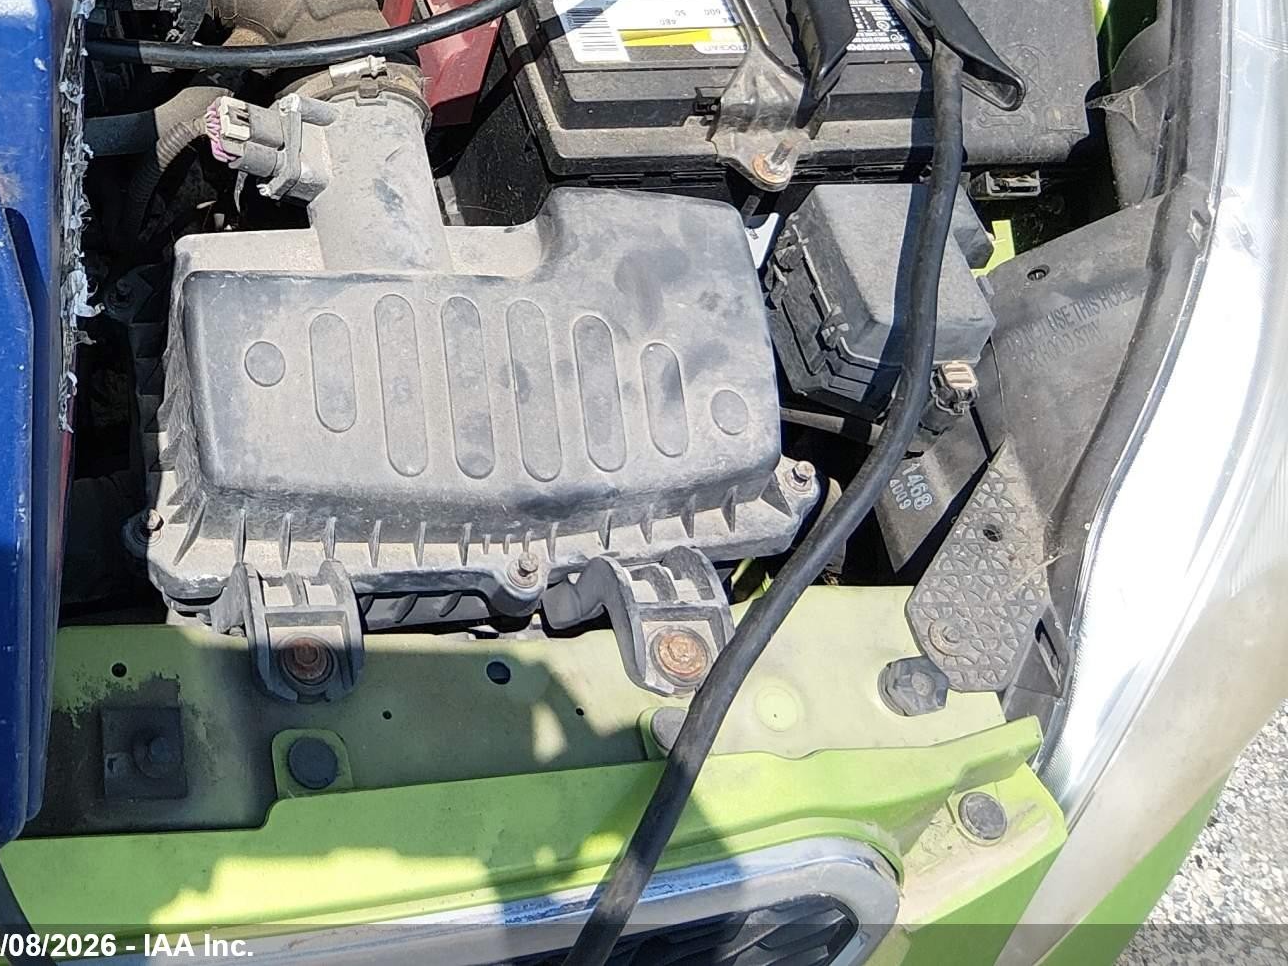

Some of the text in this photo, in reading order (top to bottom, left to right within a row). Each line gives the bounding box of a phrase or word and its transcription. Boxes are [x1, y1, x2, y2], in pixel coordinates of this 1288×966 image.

[1047, 304, 1071, 333] USE
[1071, 297, 1100, 323] THIS
[902, 462, 932, 511] 1468
